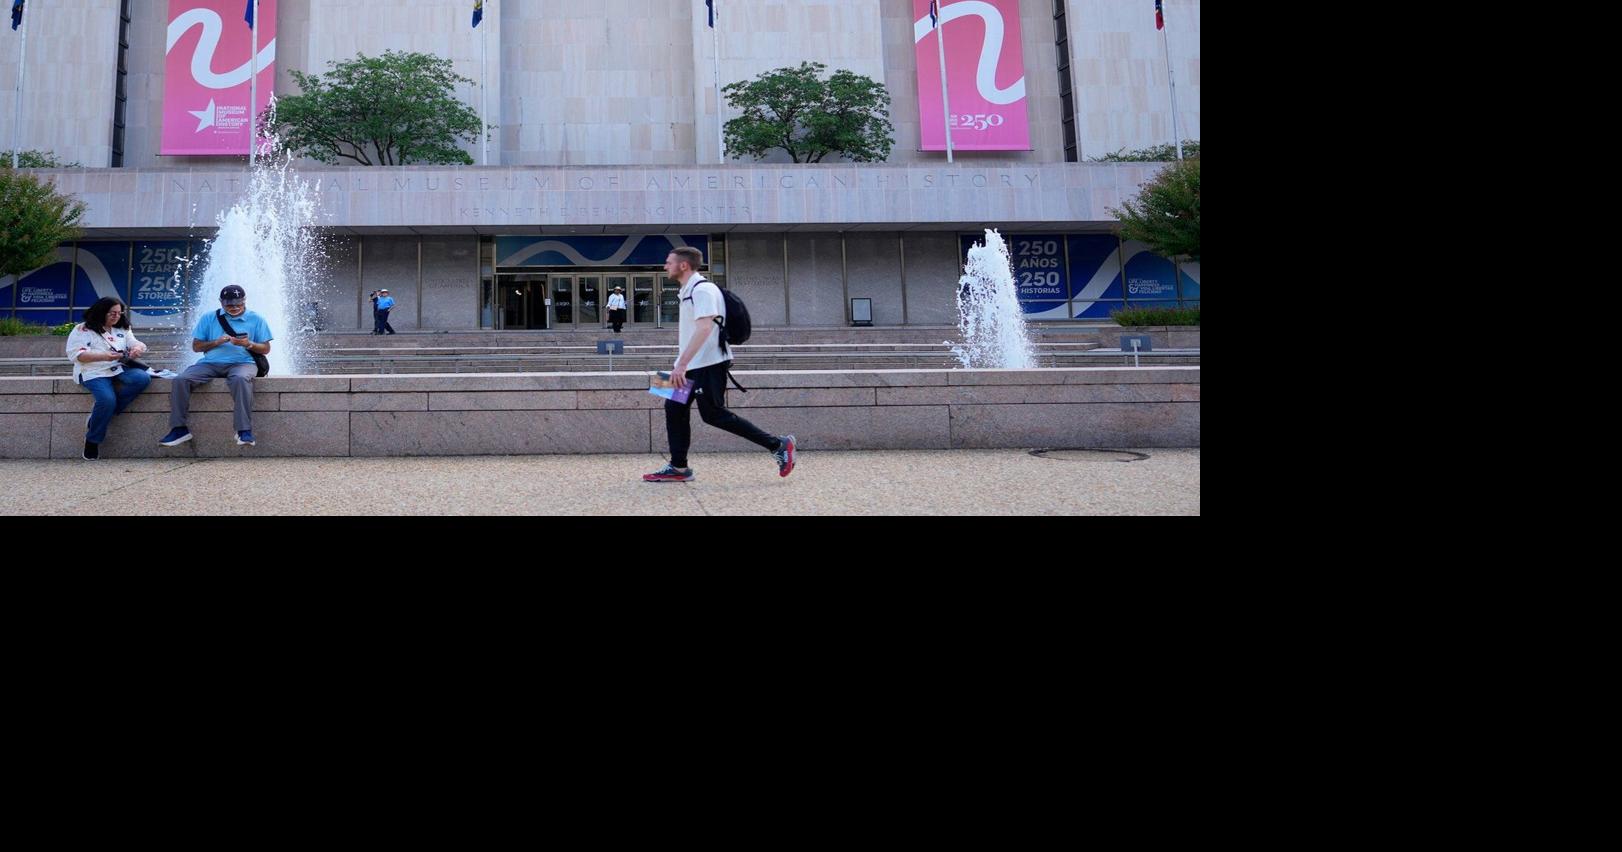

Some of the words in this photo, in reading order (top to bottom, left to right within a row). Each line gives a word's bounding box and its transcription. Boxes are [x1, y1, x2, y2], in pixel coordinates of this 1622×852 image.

[960, 113, 1004, 131] 250
[172, 177, 370, 192] NATAL
[393, 176, 551, 191] MUSEUM
[578, 176, 620, 190] OF
[646, 174, 848, 190] AMERICAN
[876, 173, 1039, 188] HISTORY
[459, 206, 548, 217] KENNETH
[677, 205, 752, 216] CENTER
[140, 248, 181, 263] 250
[1019, 240, 1058, 256] 250
[140, 263, 178, 273] YEARS
[1020, 256, 1059, 268] AÑOS
[1019, 271, 1060, 287] 250
